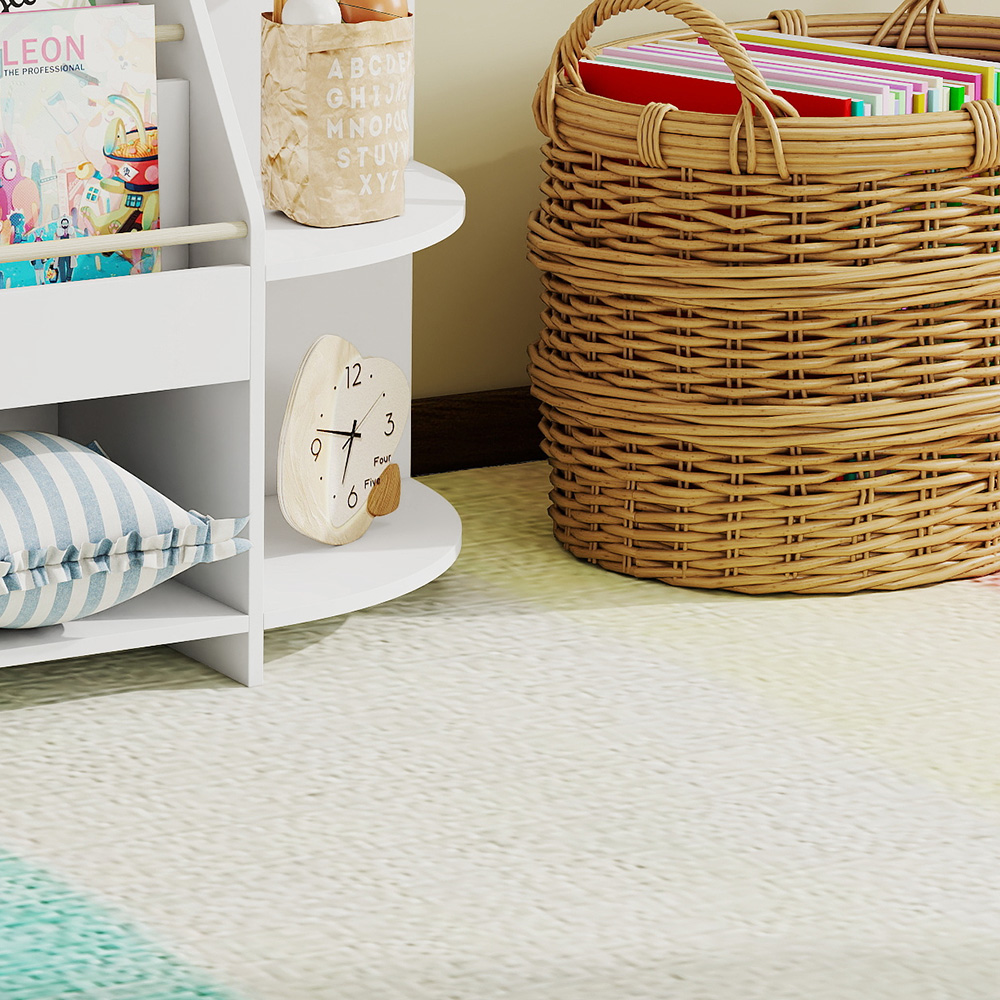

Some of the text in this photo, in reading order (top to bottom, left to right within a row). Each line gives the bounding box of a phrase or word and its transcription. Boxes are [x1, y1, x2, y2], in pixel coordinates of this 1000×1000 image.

[3, 35, 85, 66] LEON
[4, 64, 85, 77] THE PROFESSIONAL
[359, 170, 399, 196] XYZ
[345, 363, 362, 389] 12
[384, 412, 395, 436] 3
[310, 438, 322, 461] 9
[373, 454, 392, 467] Four
[364, 477, 381, 489] Five
[347, 485, 358, 508] 6
